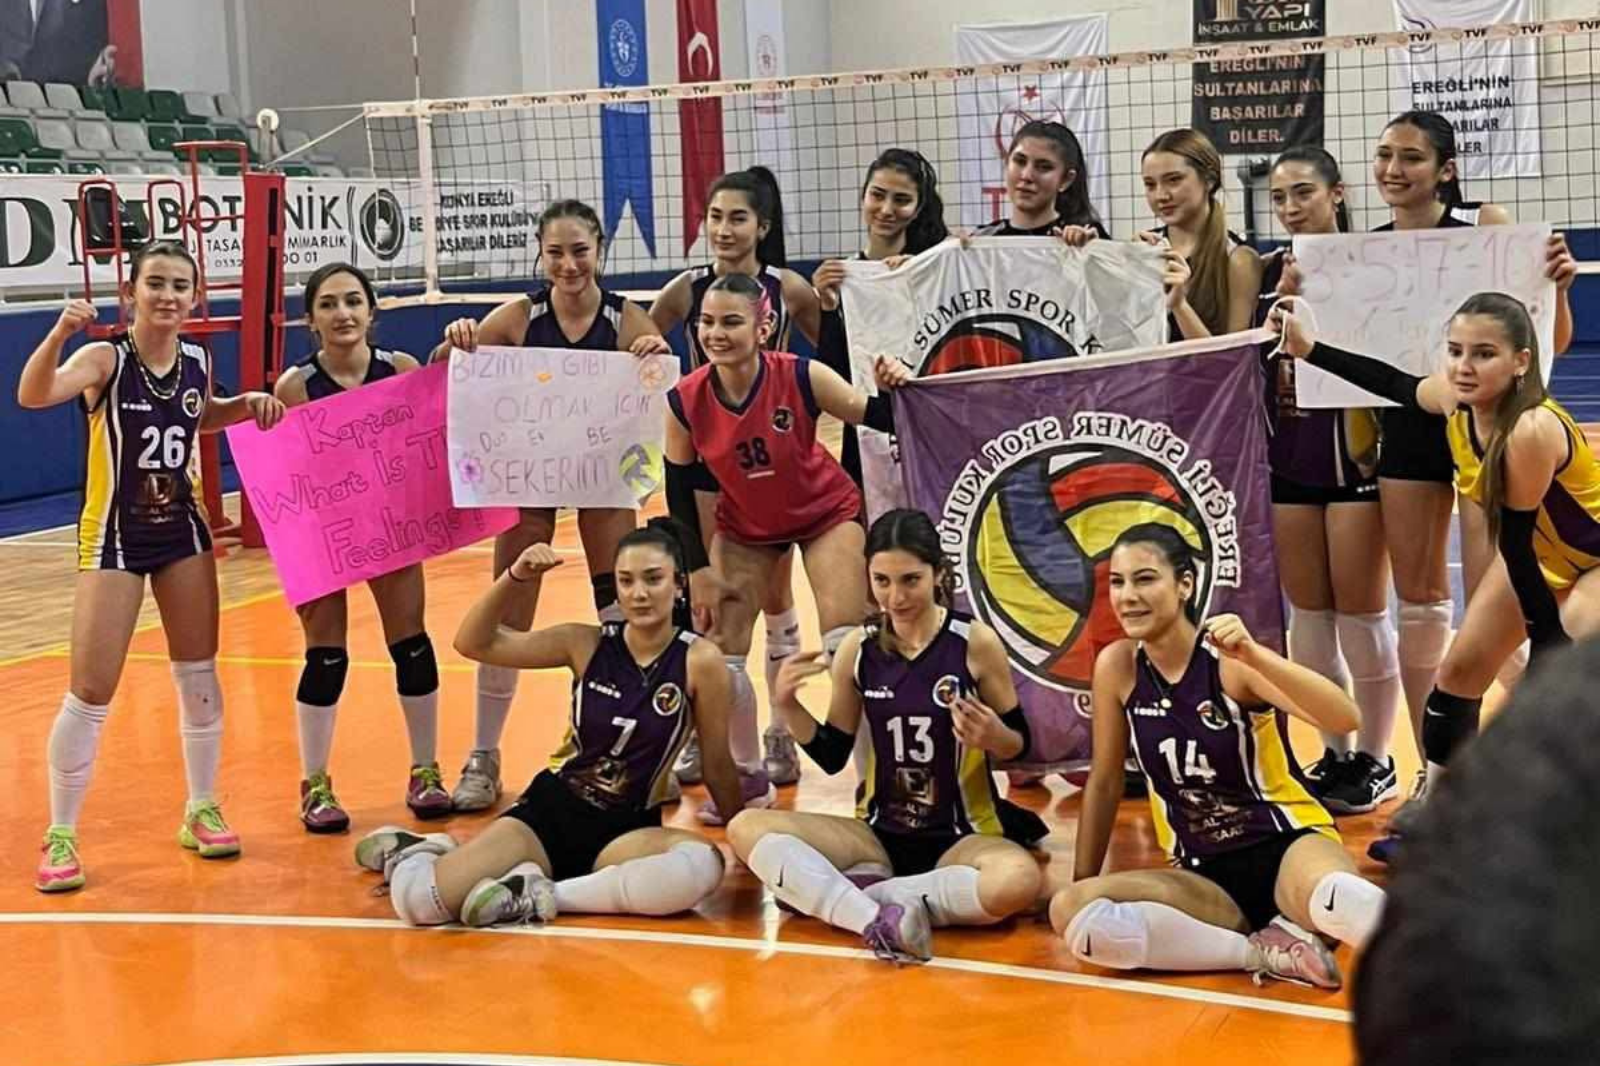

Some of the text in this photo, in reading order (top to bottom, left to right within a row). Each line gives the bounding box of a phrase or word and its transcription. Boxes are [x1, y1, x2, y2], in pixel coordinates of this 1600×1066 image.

[1244, 3, 1310, 19] YAPI
[1268, 19, 1320, 33] EMLAK
[777, 80, 795, 89] TVF
[820, 77, 839, 86] TVF
[864, 74, 884, 82] TVF
[910, 71, 928, 80] TVF
[956, 68, 974, 76] TVF
[1002, 64, 1022, 73] TVF
[1050, 60, 1069, 70] TVF
[1098, 56, 1119, 66] TVF
[1148, 53, 1168, 62] TVF
[1198, 50, 1219, 59] TVF
[1250, 46, 1271, 54] TVF
[1302, 42, 1324, 50] TVF
[1354, 36, 1376, 46] TVF
[1409, 32, 1432, 42] TVF
[1464, 28, 1488, 38] TVF
[1521, 25, 1544, 34] TVF
[1578, 20, 1600, 30] TVF
[1194, 79, 1322, 97] SULTANLARINA
[158, 186, 342, 234] BOTNİK
[914, 288, 1076, 350] SÜMER SPOR
[138, 425, 186, 469] 26
[735, 436, 771, 470] 38
[252, 473, 368, 524] What
[610, 717, 638, 757] 7
[887, 716, 935, 763] 13
[1159, 738, 1217, 785] 14
